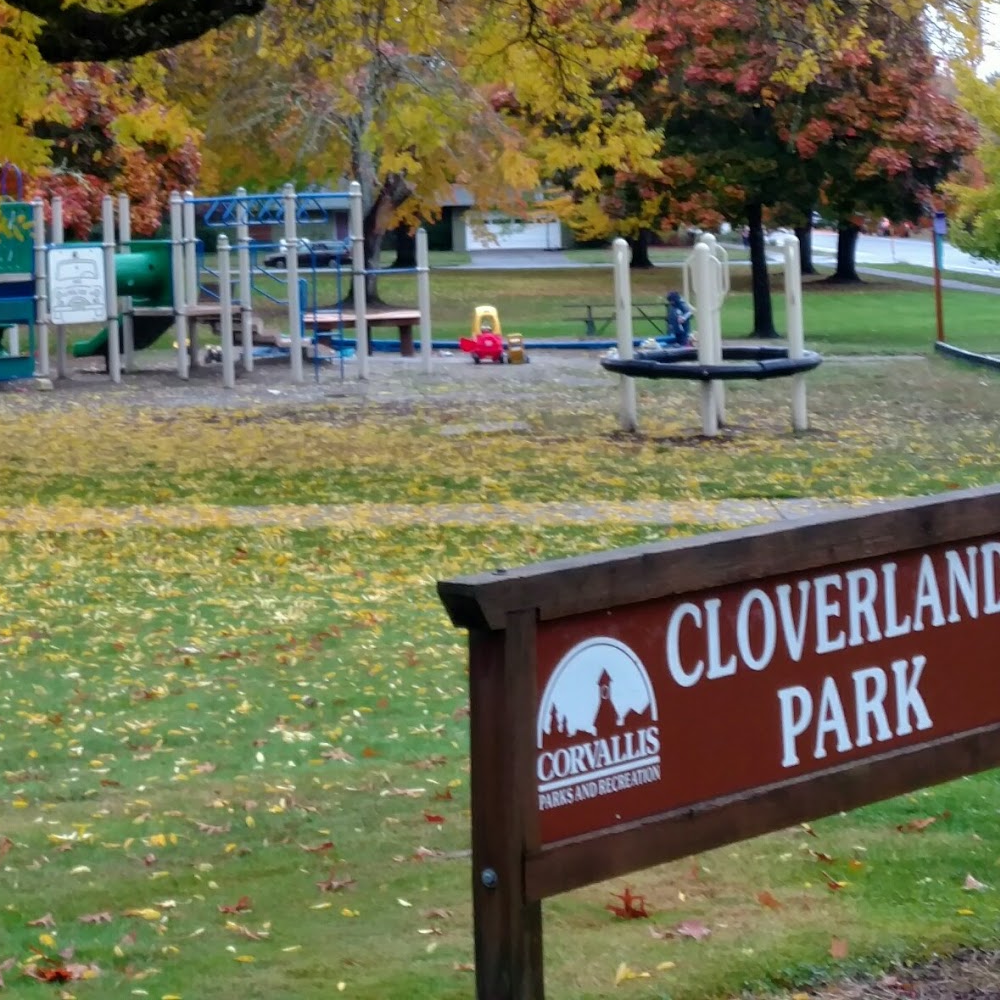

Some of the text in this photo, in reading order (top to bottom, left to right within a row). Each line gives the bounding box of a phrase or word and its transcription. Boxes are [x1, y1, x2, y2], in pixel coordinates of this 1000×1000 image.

[666, 542, 1000, 688] CLOVERLAND
[537, 726, 661, 781] CORVALLIS
[777, 655, 933, 768] PARK
[538, 764, 661, 811] PARKS AND RECREATION
